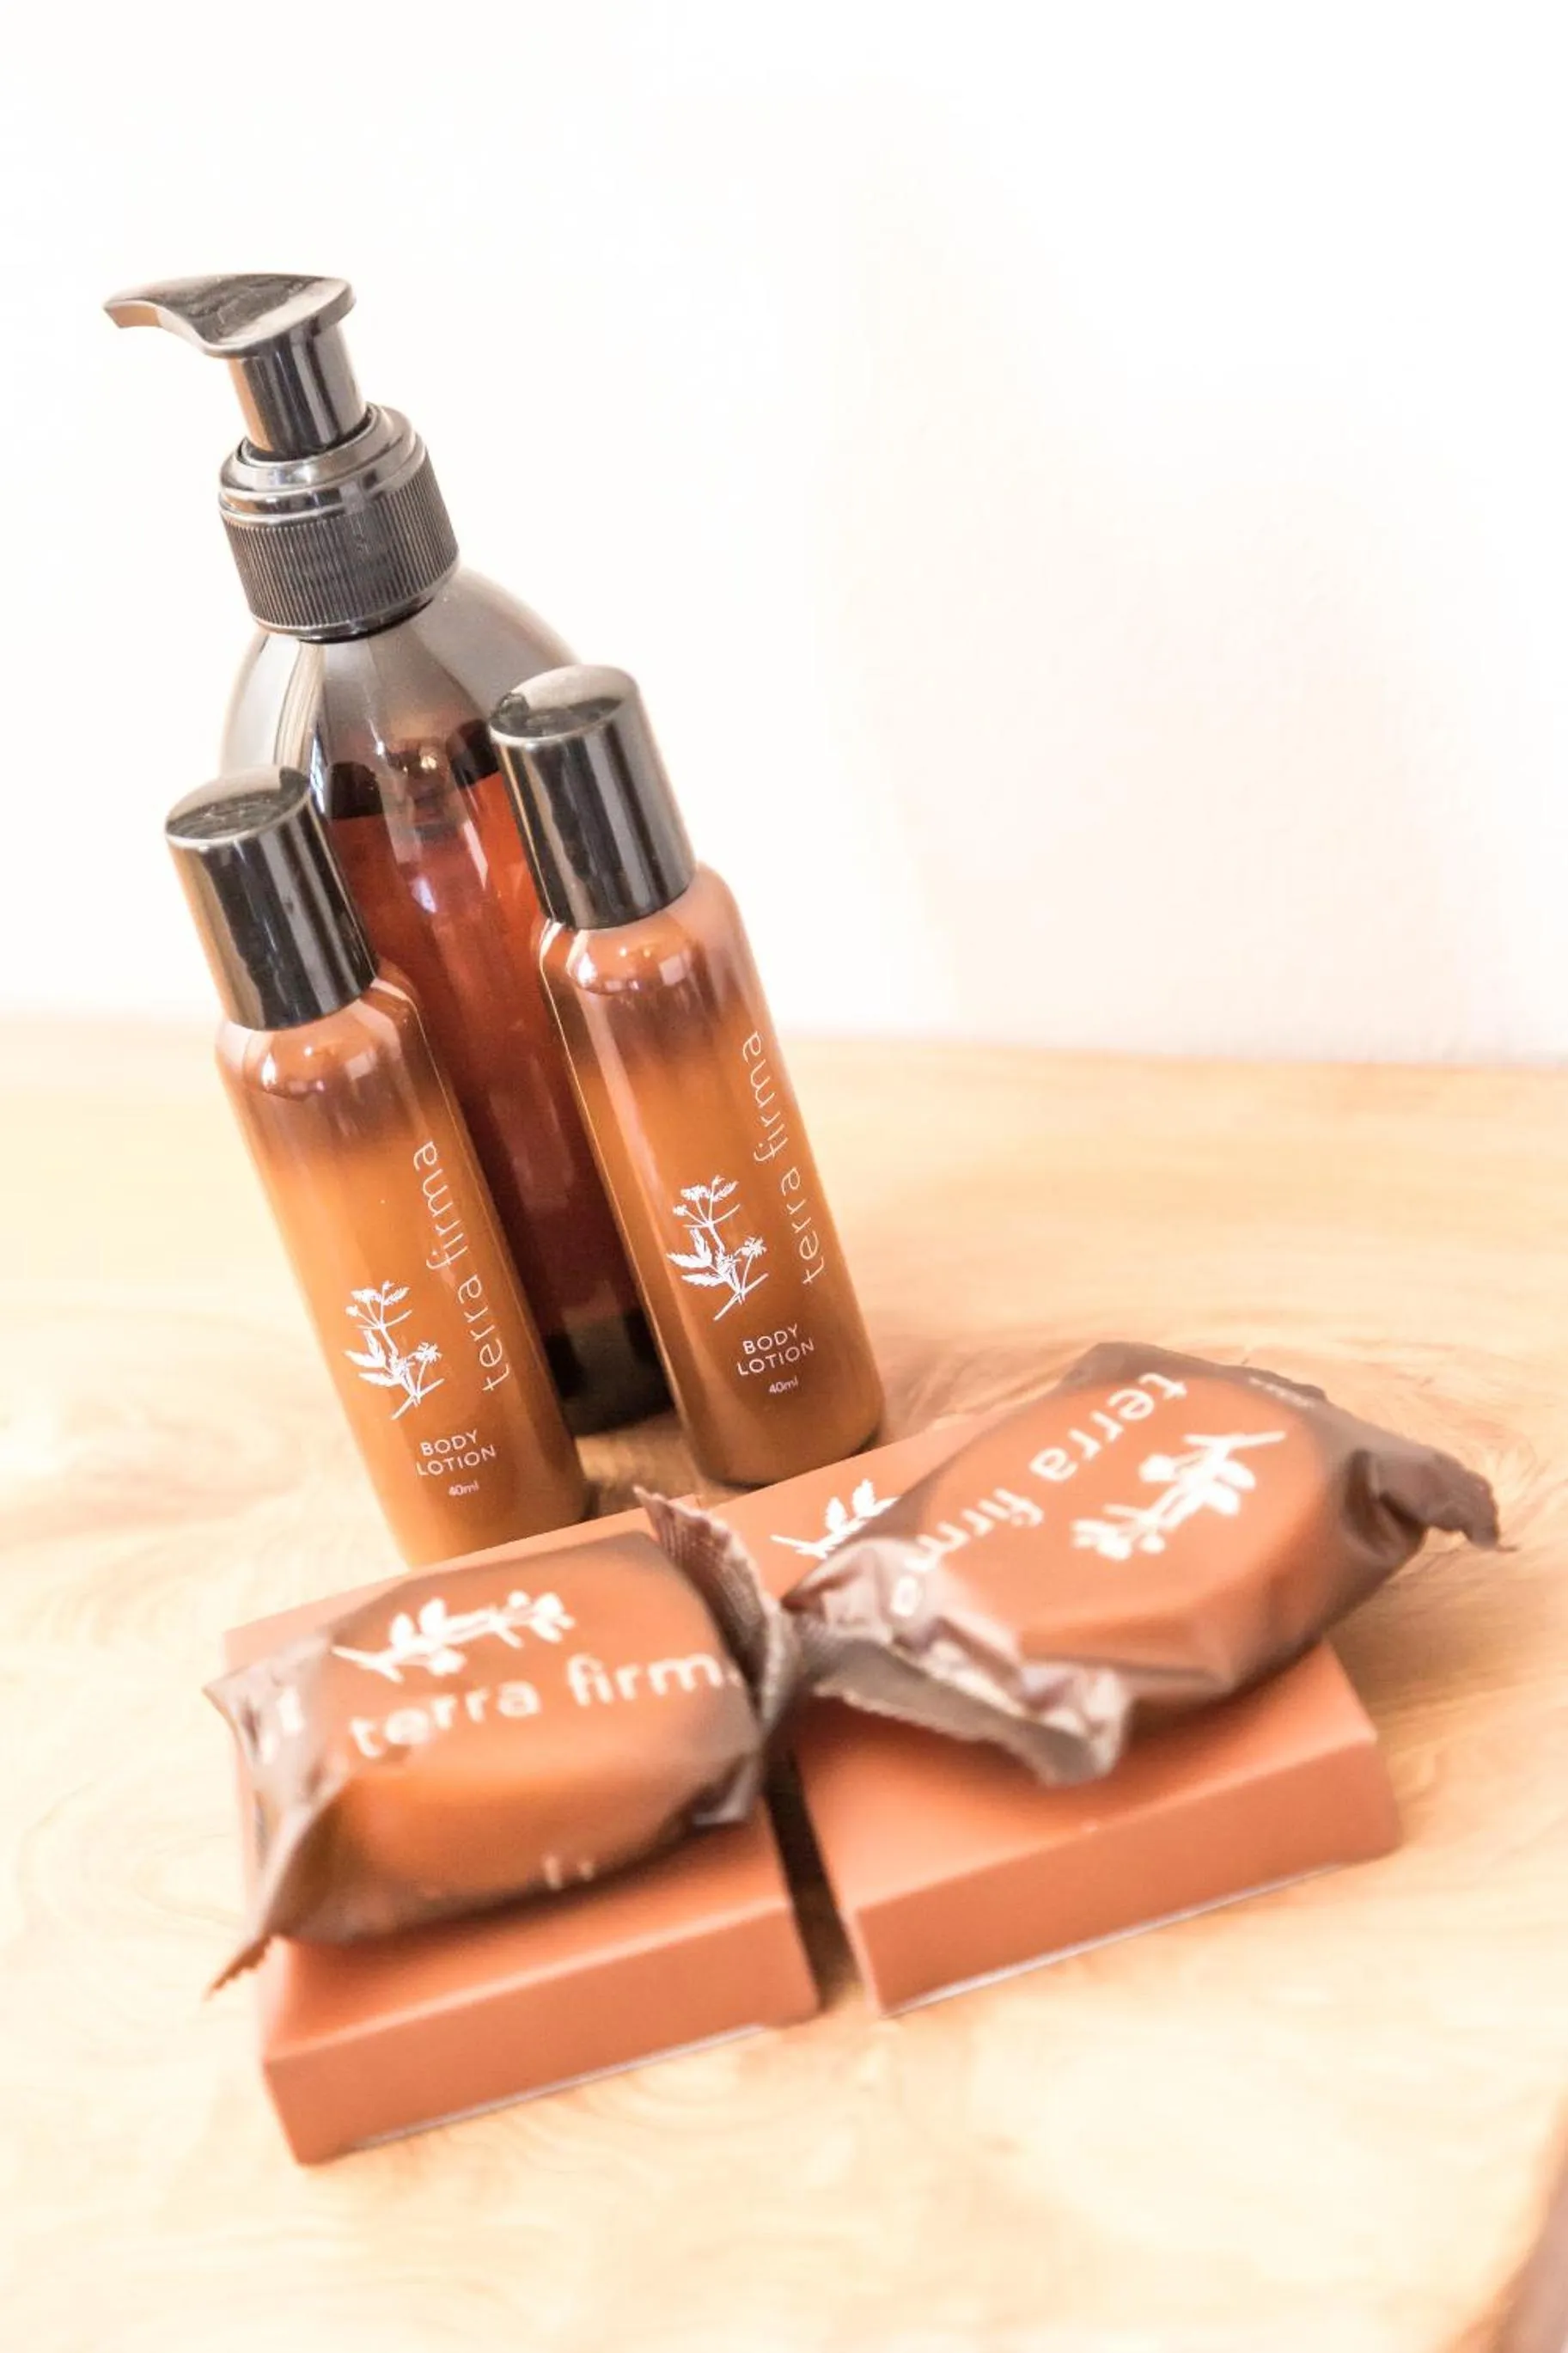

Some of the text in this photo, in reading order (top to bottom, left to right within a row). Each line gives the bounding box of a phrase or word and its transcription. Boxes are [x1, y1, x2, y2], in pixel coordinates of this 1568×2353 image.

[743, 1030, 825, 1286] terra firma
[412, 1140, 510, 1393] terra firma
[742, 1323, 797, 1354] BODY
[737, 1337, 815, 1376] LOTION
[769, 1375, 799, 1394] 40ml
[420, 1428, 477, 1457] BODY
[1029, 1372, 1187, 1482] terra
[416, 1444, 496, 1476] LOTION
[448, 1480, 479, 1496] 40ml
[349, 1653, 742, 1758] terra firm
